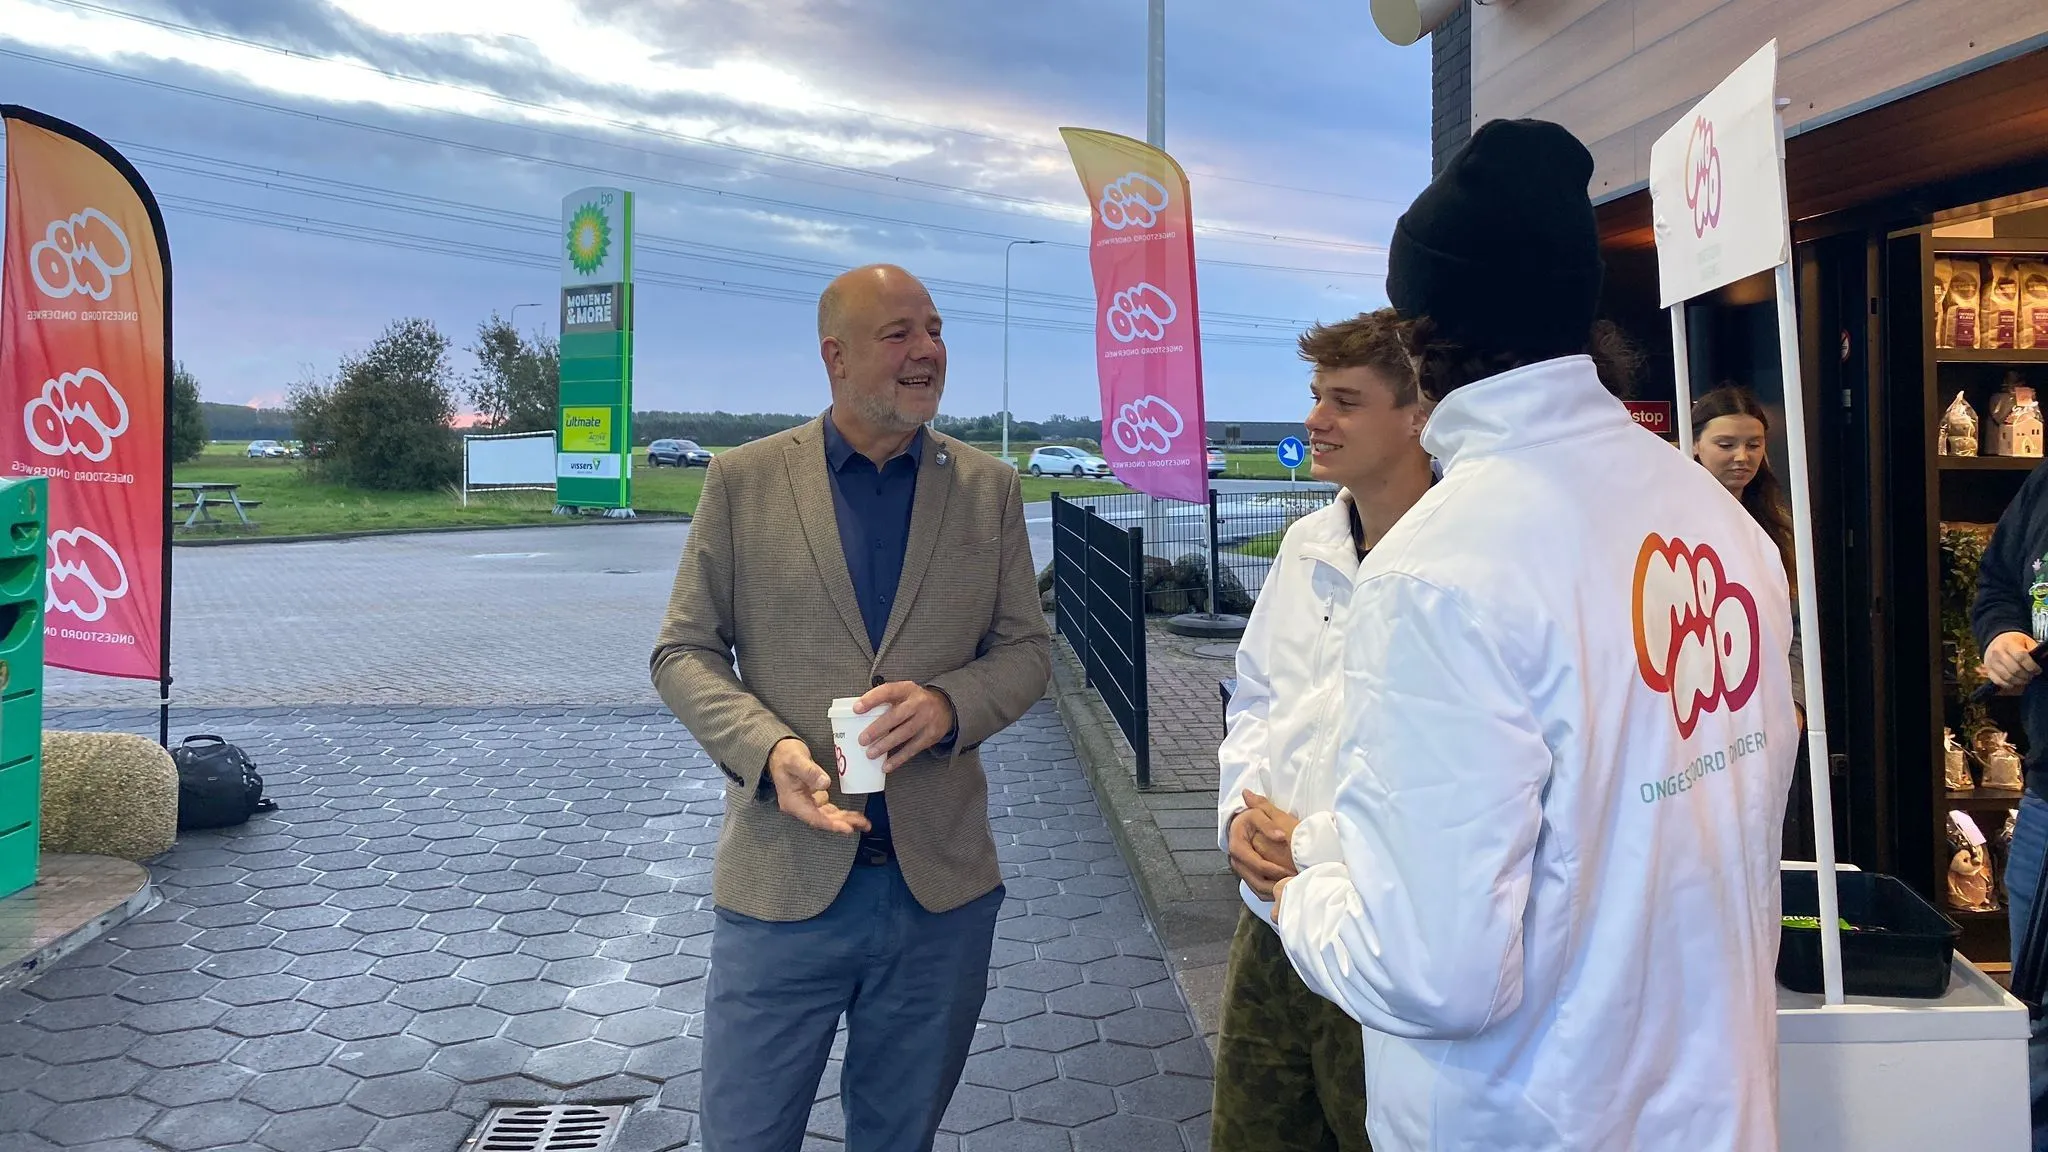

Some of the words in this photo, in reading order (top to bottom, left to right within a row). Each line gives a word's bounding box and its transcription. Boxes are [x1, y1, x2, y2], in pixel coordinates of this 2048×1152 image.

[601, 192, 613, 206] bp
[567, 293, 612, 308] MOMENTS
[567, 305, 612, 325] &MORE
[1628, 409, 1664, 426] stop
[571, 462, 593, 470] vissers
